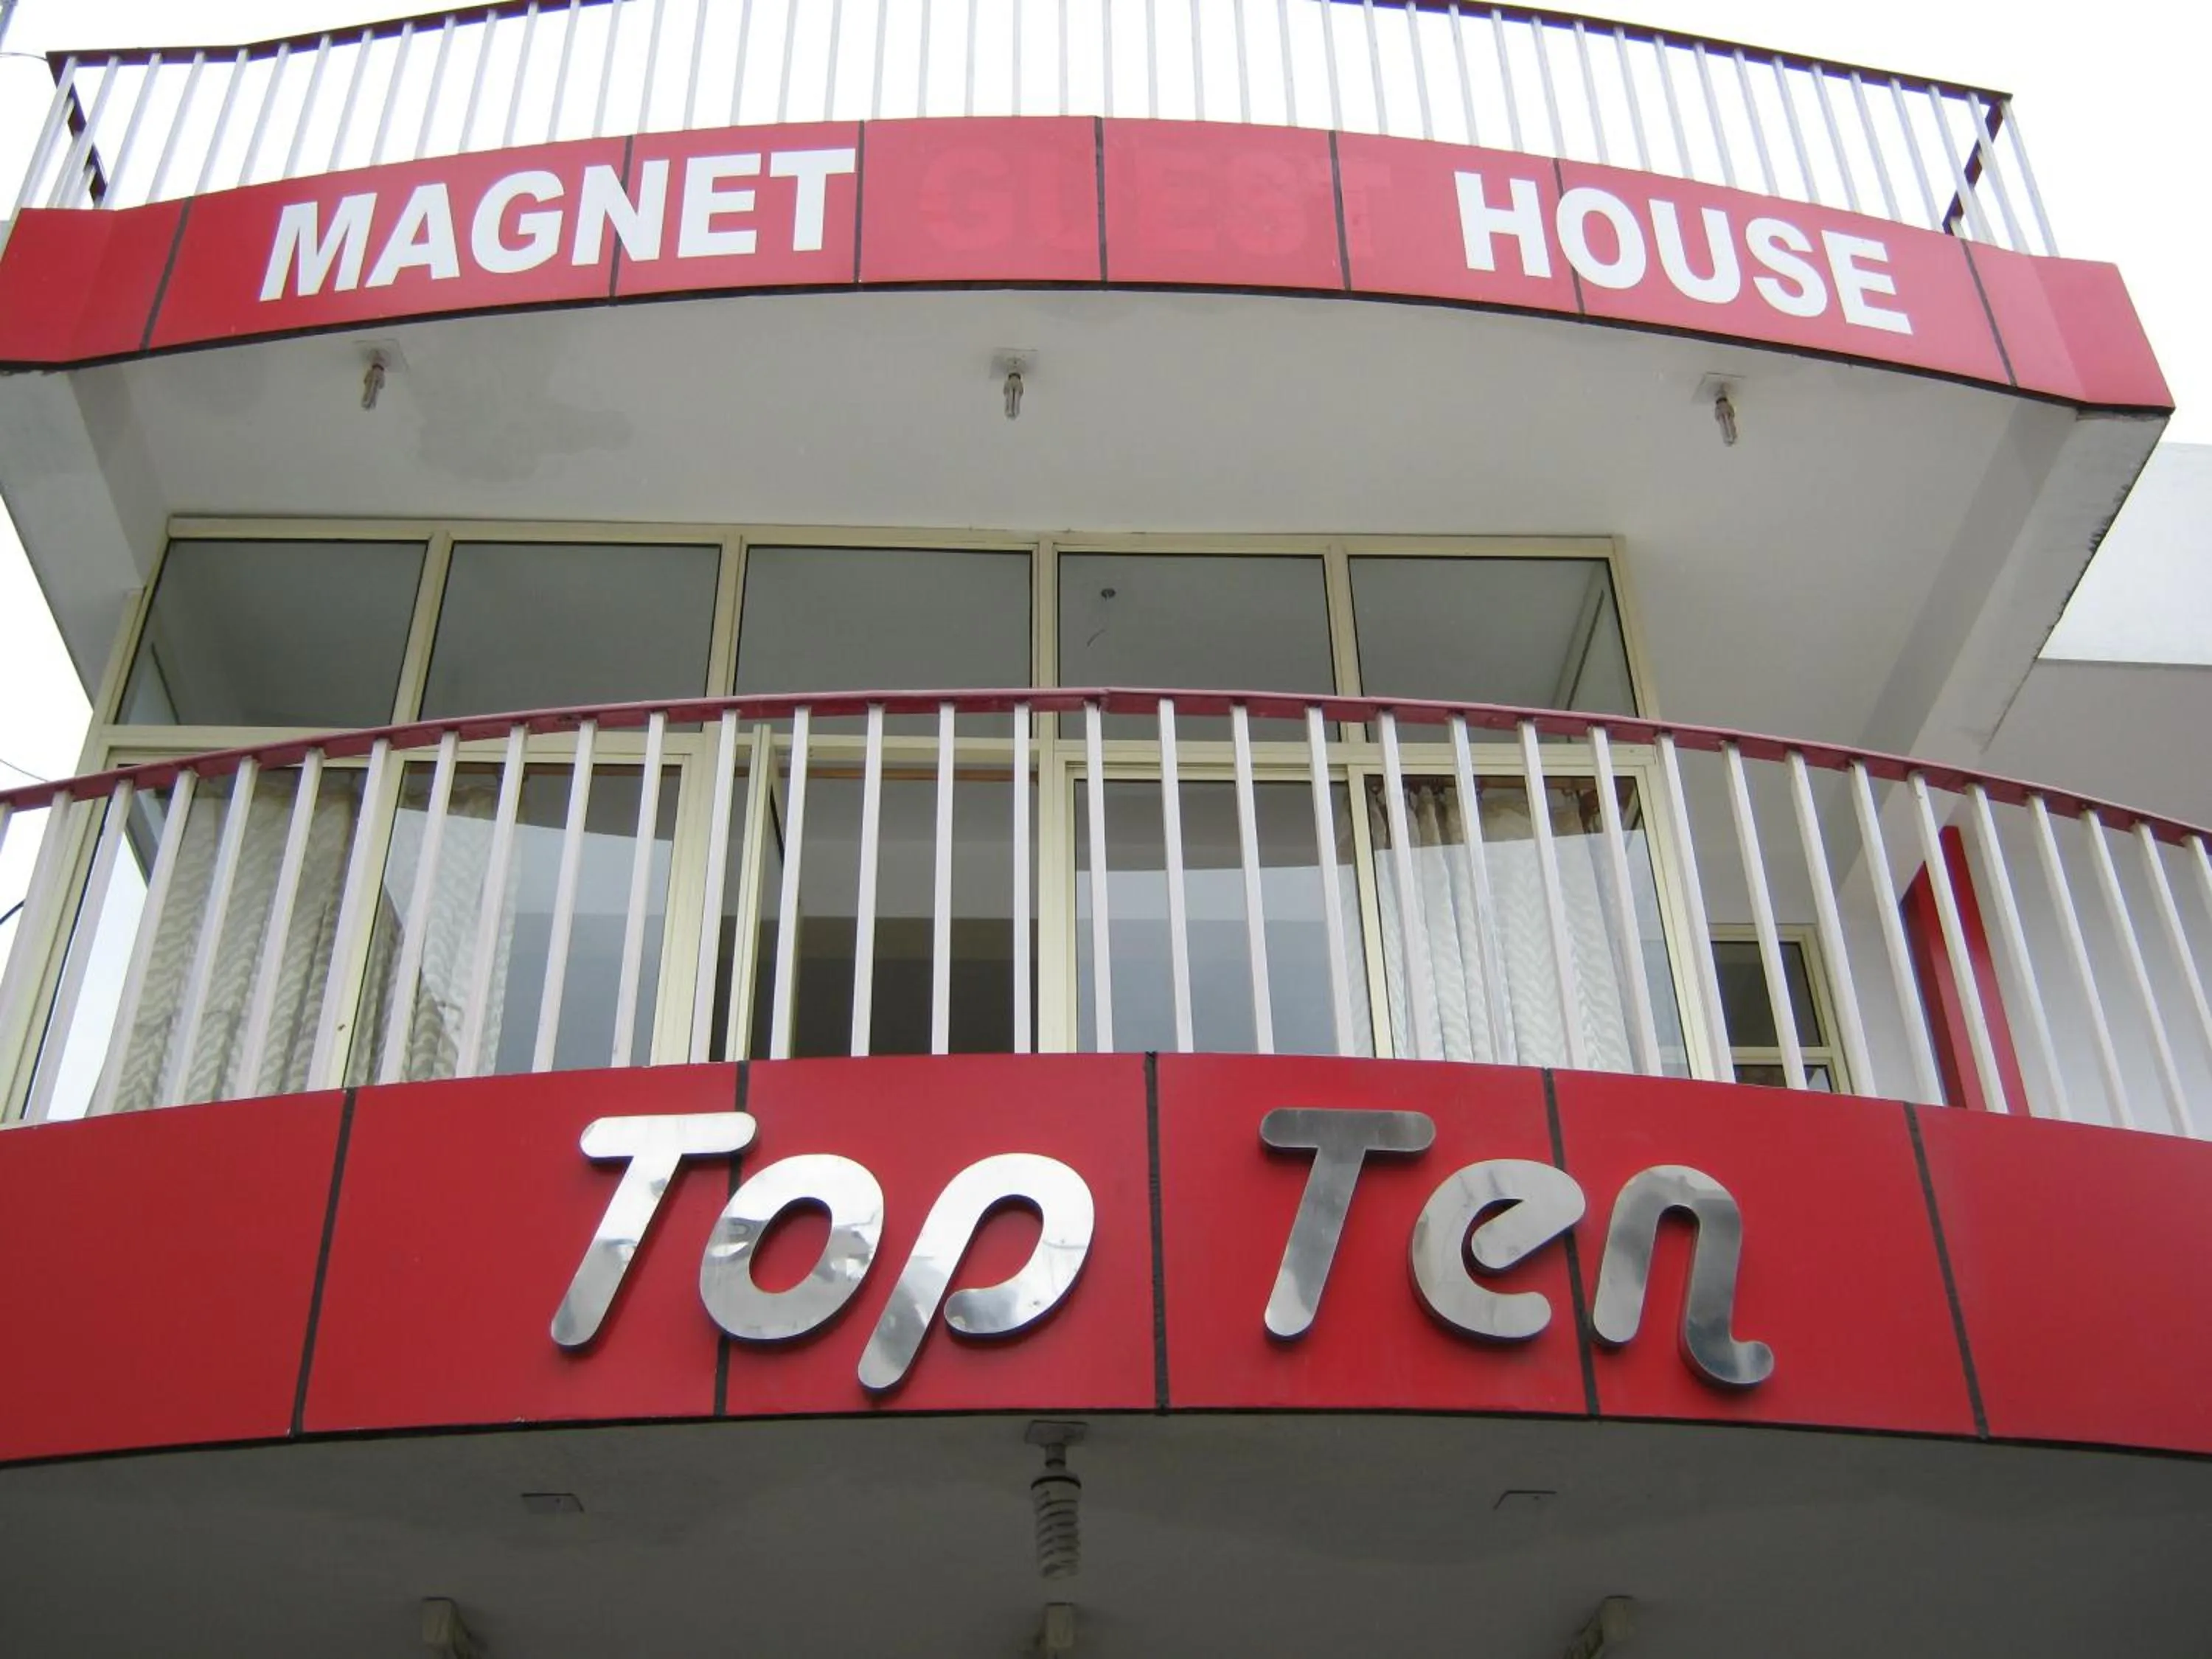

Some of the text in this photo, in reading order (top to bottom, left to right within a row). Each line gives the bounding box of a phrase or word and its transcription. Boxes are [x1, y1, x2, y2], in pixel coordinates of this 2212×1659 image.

[258, 147, 857, 302] MAGNET
[1453, 170, 1913, 335] HOUSE
[551, 1107, 1775, 1391] Top Ten
